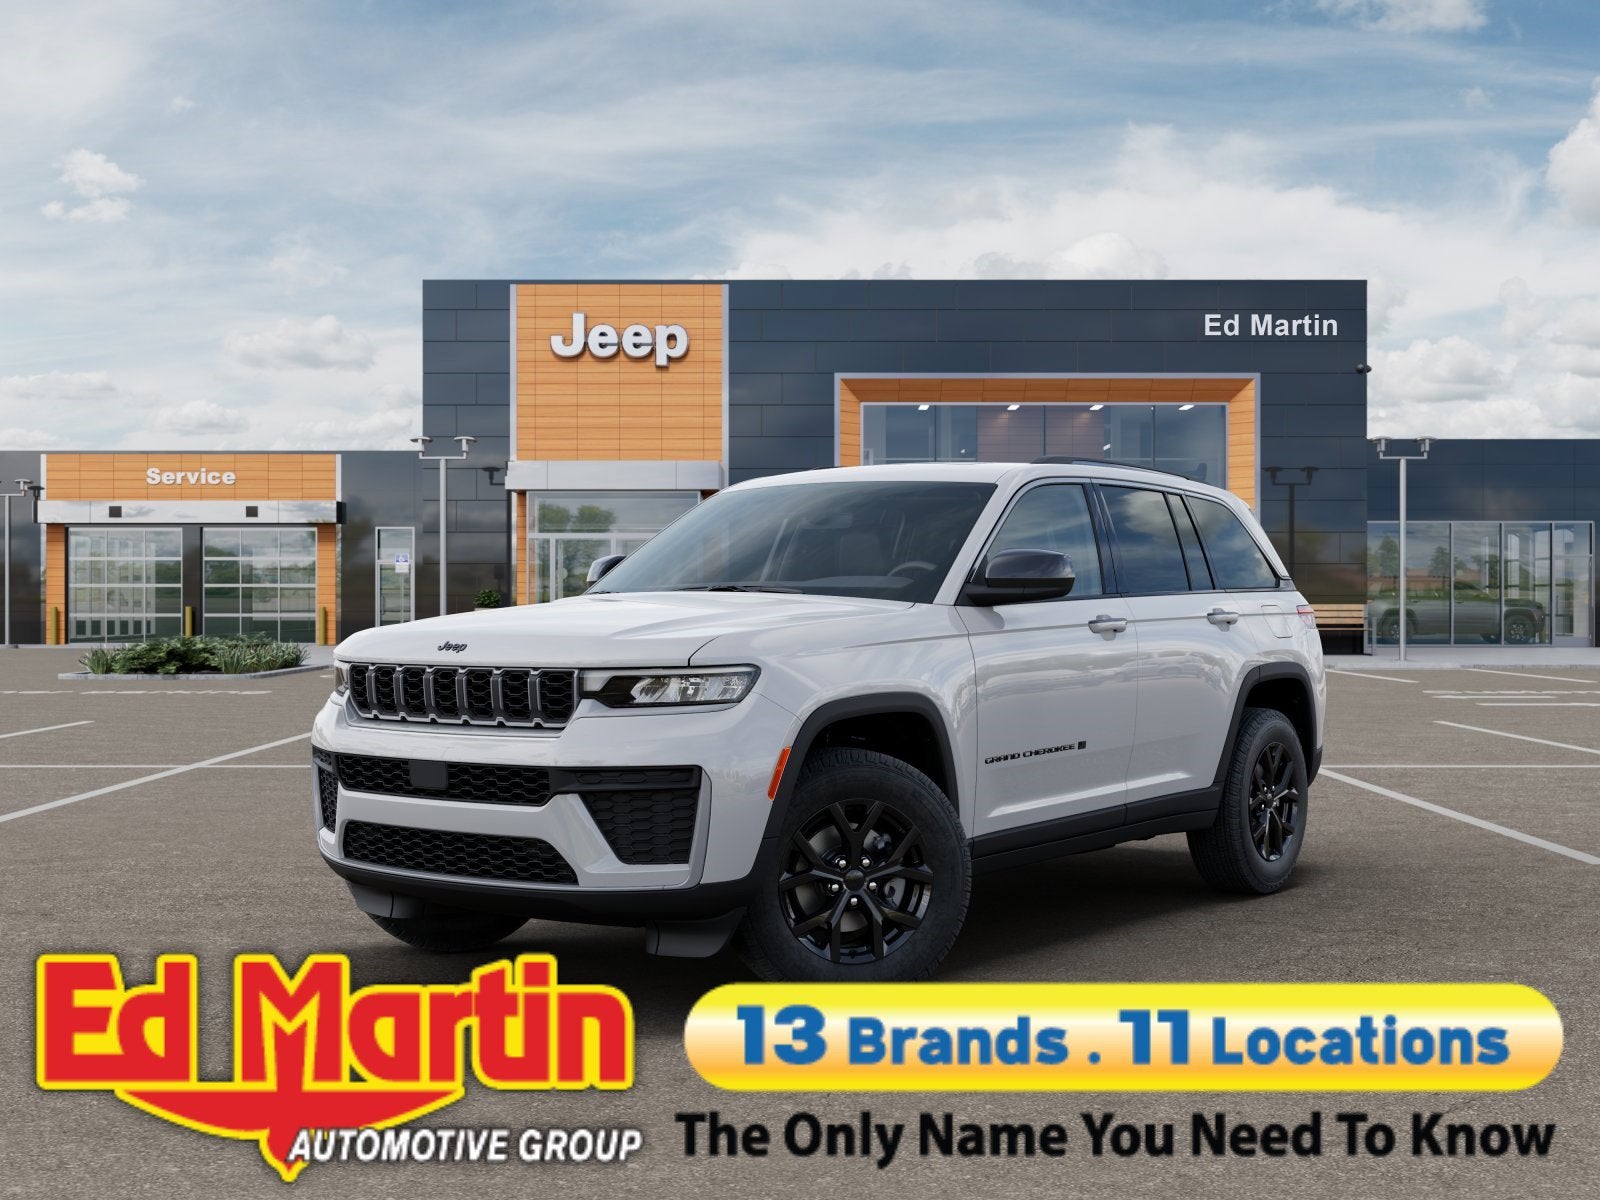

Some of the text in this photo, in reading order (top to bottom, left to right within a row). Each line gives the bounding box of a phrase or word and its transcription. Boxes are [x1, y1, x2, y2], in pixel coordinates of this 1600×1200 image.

[1204, 314, 1338, 336] Ed Martin
[550, 312, 689, 367] Jeep
[146, 467, 236, 485] Service
[437, 641, 468, 653] Jeep
[984, 743, 1076, 765] GRAND CHEROKEE
